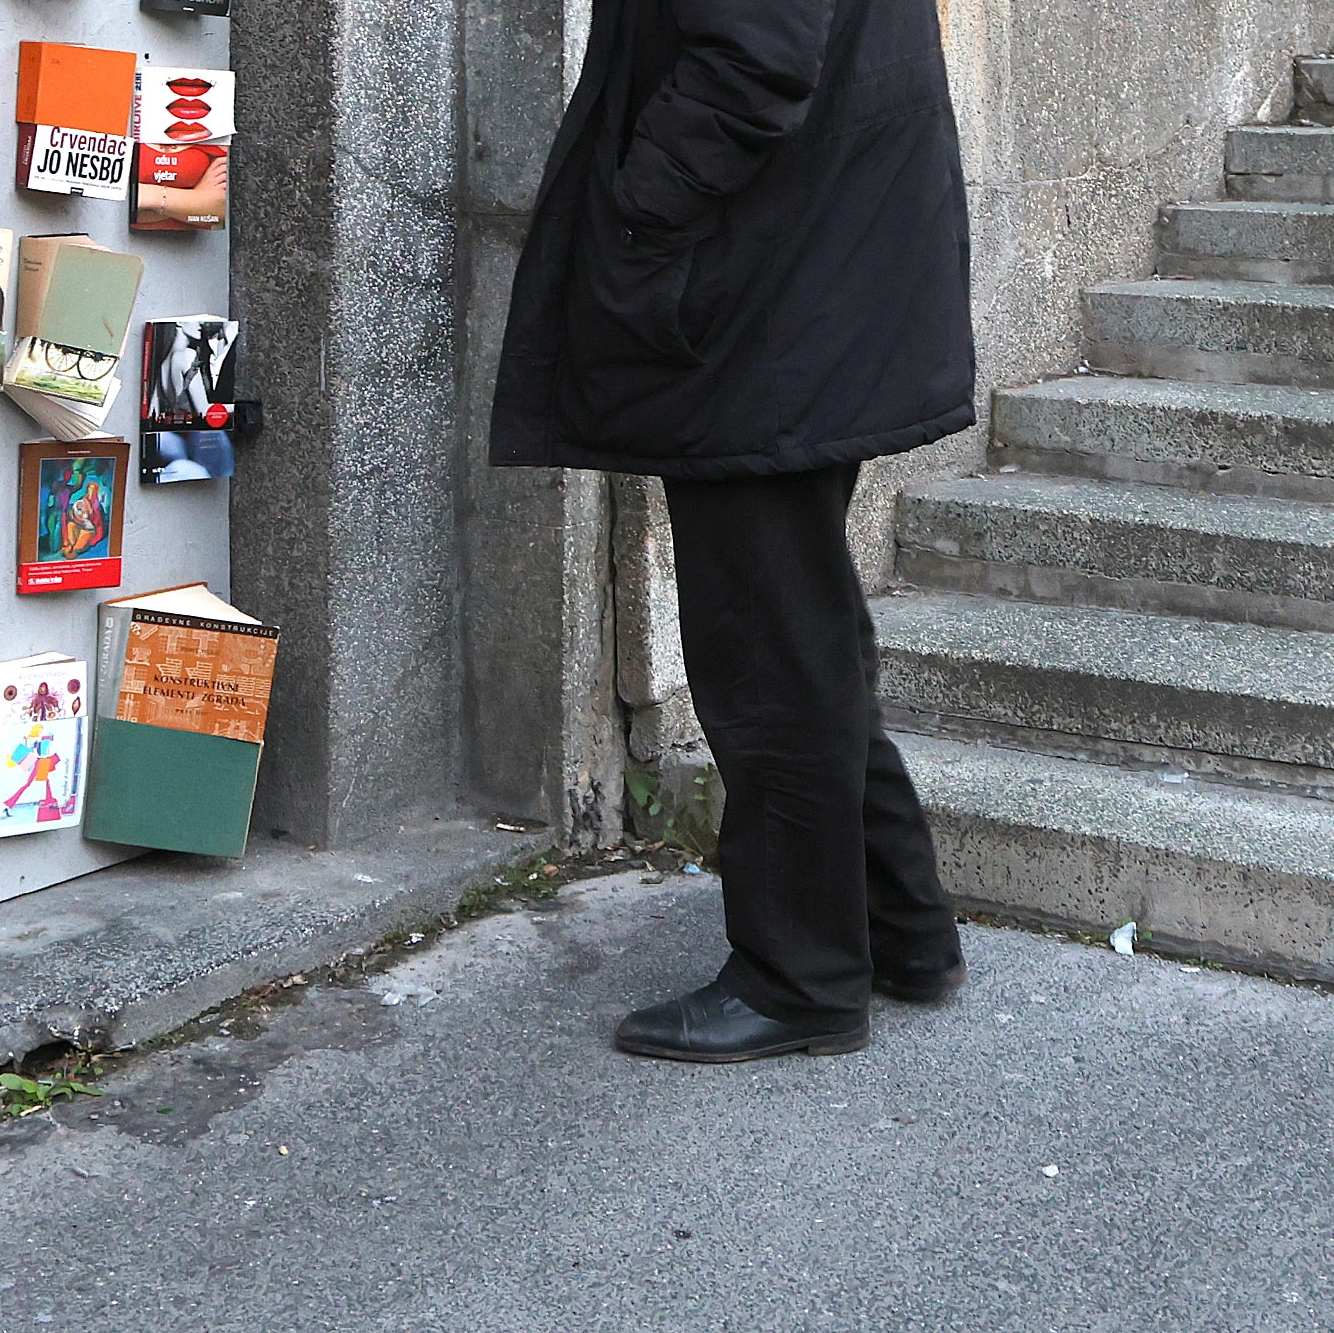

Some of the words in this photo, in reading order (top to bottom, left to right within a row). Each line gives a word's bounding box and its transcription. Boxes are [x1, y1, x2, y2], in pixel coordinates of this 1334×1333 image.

[49, 125, 127, 157] Crvendać
[37, 148, 62, 175] JO
[64, 152, 125, 184] NESBØ
[154, 156, 170, 166] odu
[171, 157, 178, 166] u
[153, 170, 178, 183] vjetar
[135, 613, 192, 627] GRAĐEVNE
[199, 621, 275, 637] KONSTRUKCIJE
